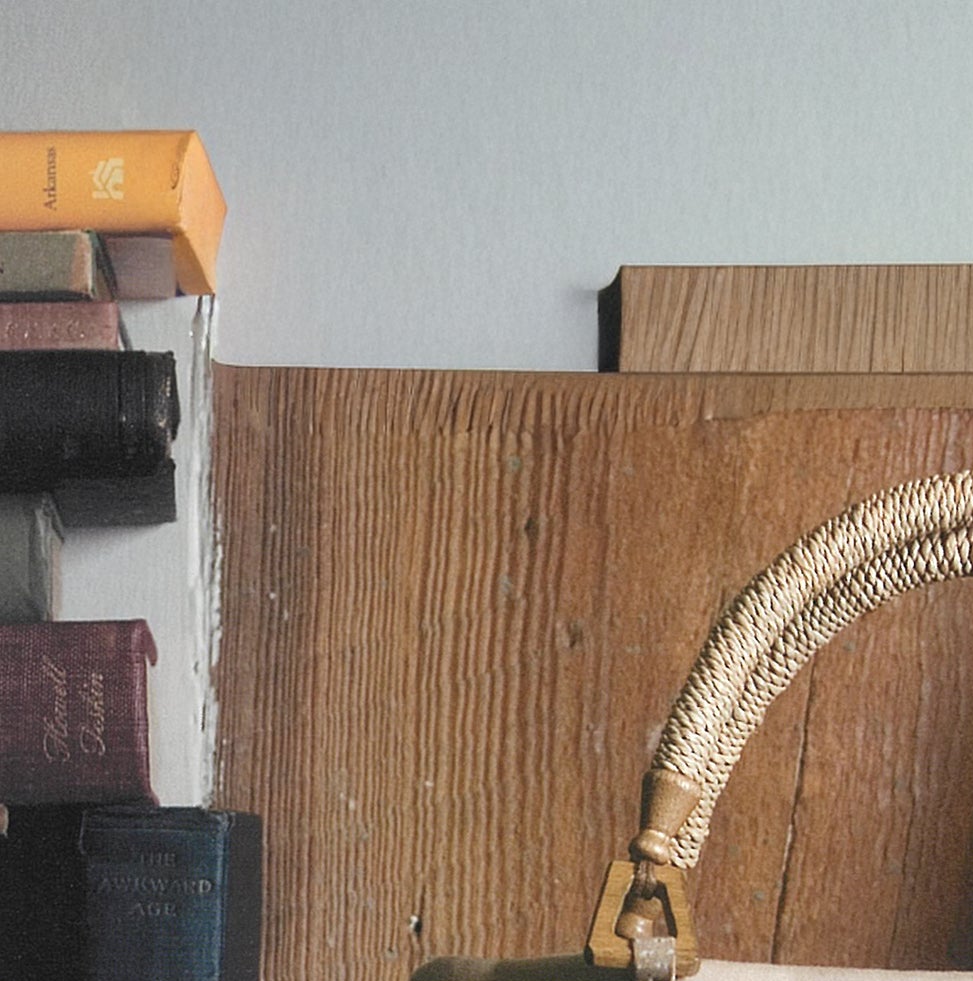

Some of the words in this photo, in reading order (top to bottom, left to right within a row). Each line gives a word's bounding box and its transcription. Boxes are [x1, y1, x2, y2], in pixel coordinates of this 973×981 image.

[43, 146, 57, 211] Arkansas
[139, 852, 177, 868] THE
[100, 878, 212, 896] AWKWARD
[129, 902, 177, 918] AGE
